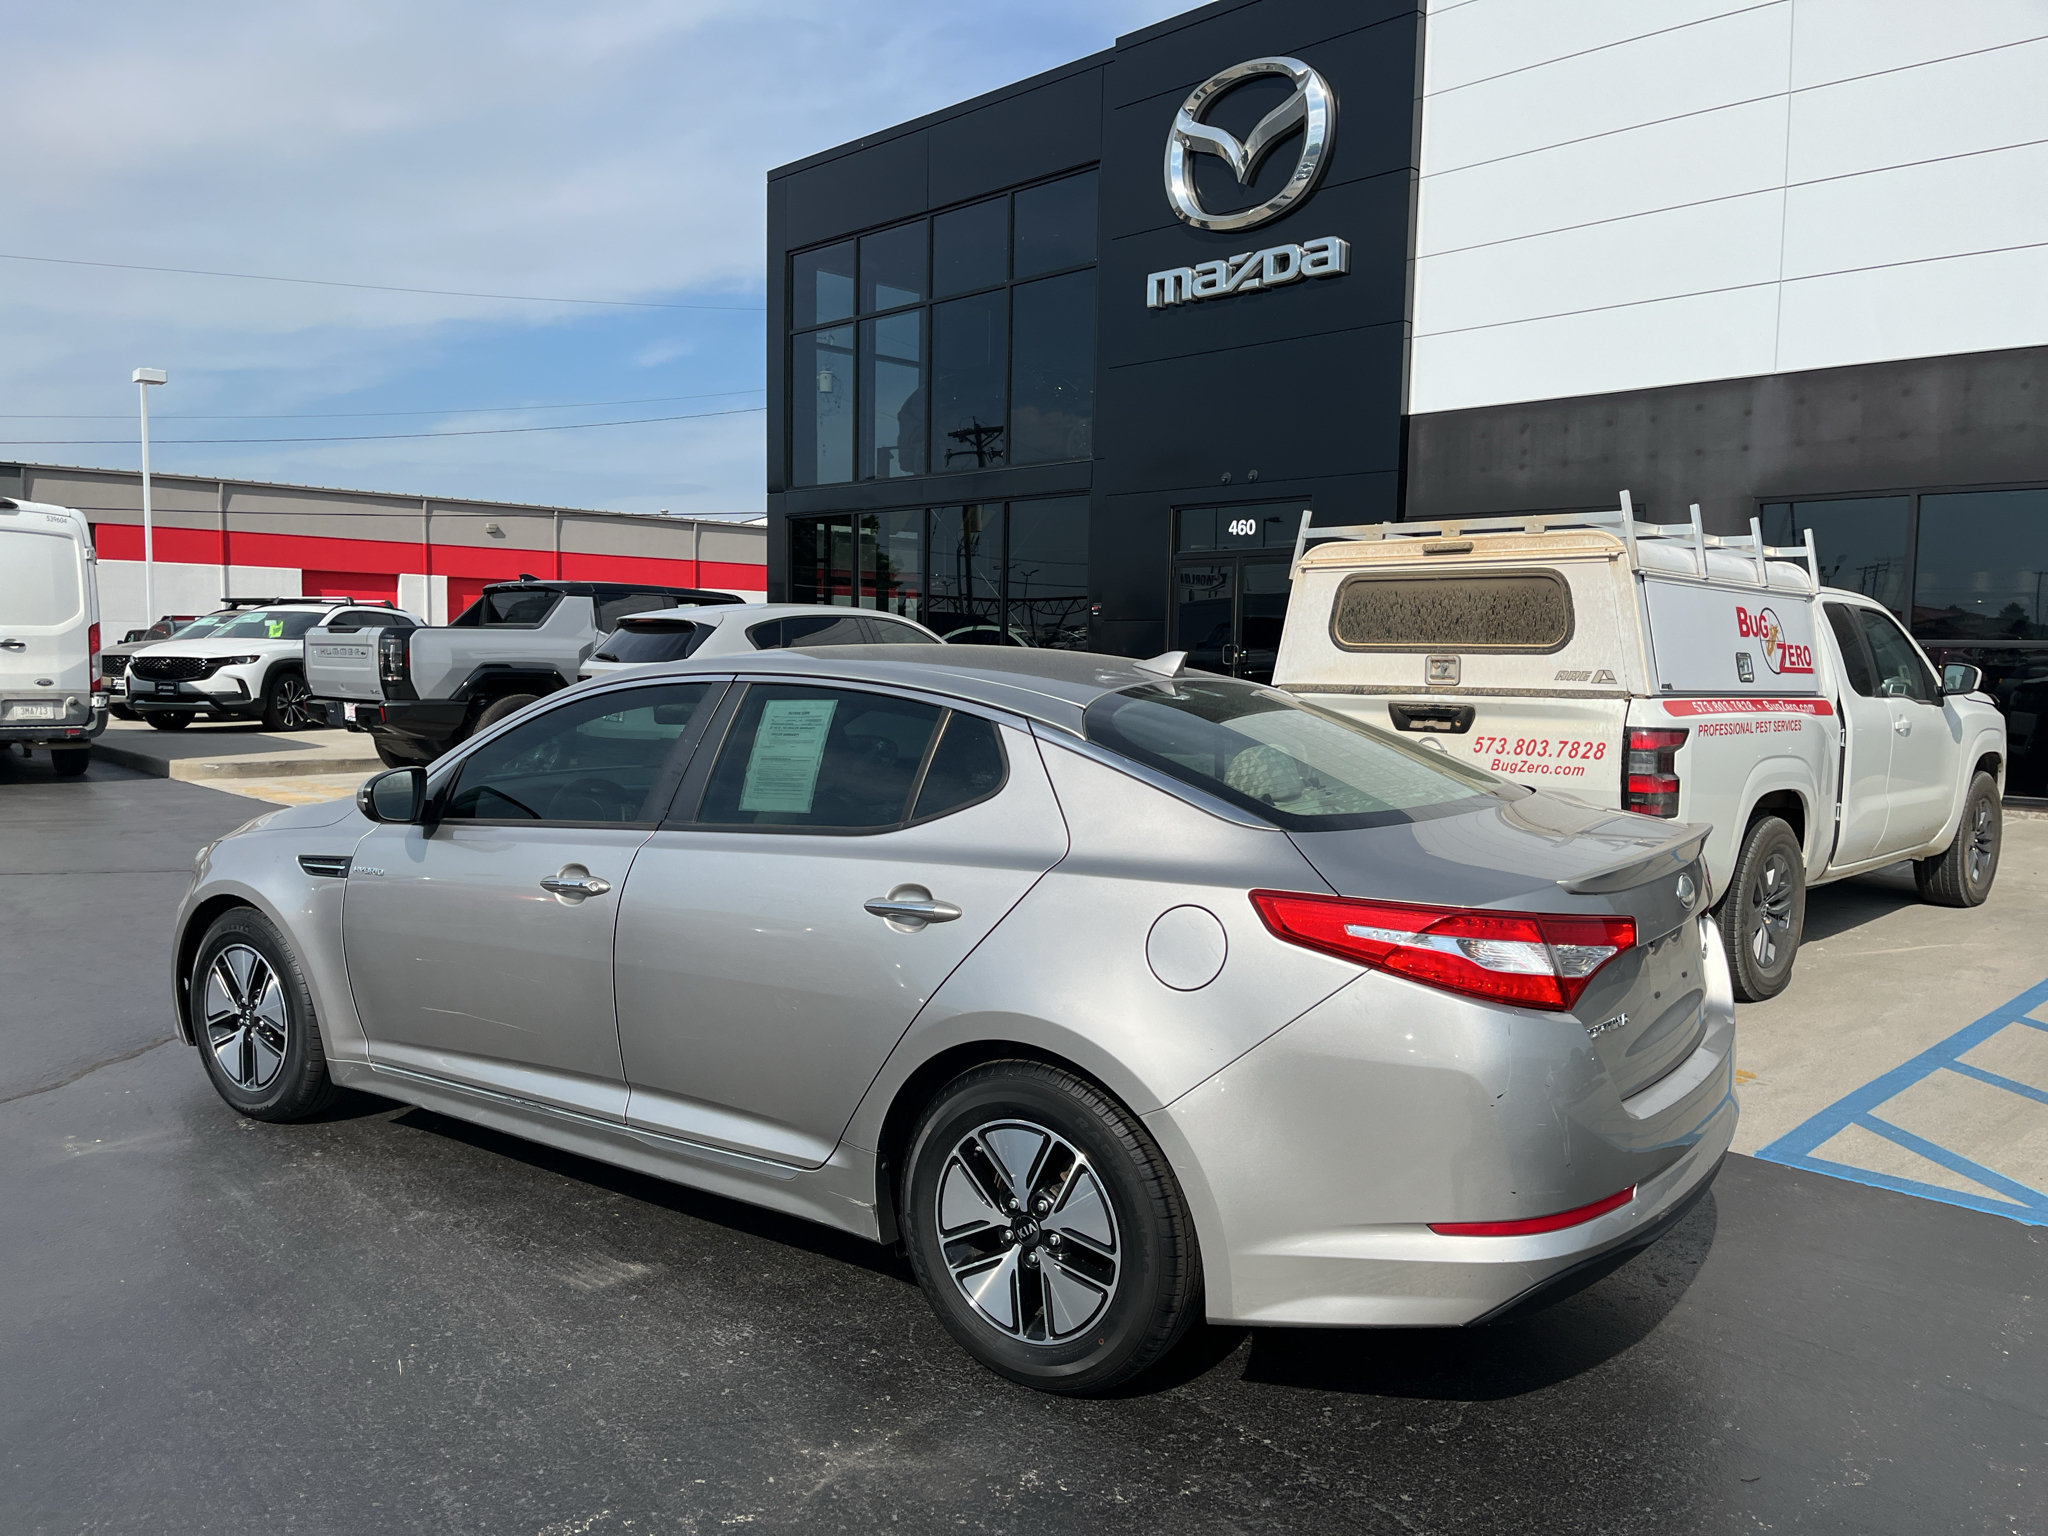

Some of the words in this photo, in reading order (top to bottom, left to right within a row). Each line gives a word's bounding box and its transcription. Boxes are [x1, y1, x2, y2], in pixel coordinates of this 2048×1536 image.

[1228, 519, 1256, 536] 460
[320, 647, 360, 656] HUMMER
[1554, 669, 1592, 682] ARE
[1691, 700, 1756, 713] 573.803.7828
[1763, 700, 1816, 713] BugZero.com
[1698, 722, 1754, 737] PROFESSIONAL
[1755, 720, 1771, 734] PEST
[1773, 719, 1802, 733] SERVICES
[1473, 736, 1606, 760] 573.803.7828
[1490, 758, 1585, 777] BugZero.com
[1017, 1222, 1038, 1239] KIA
